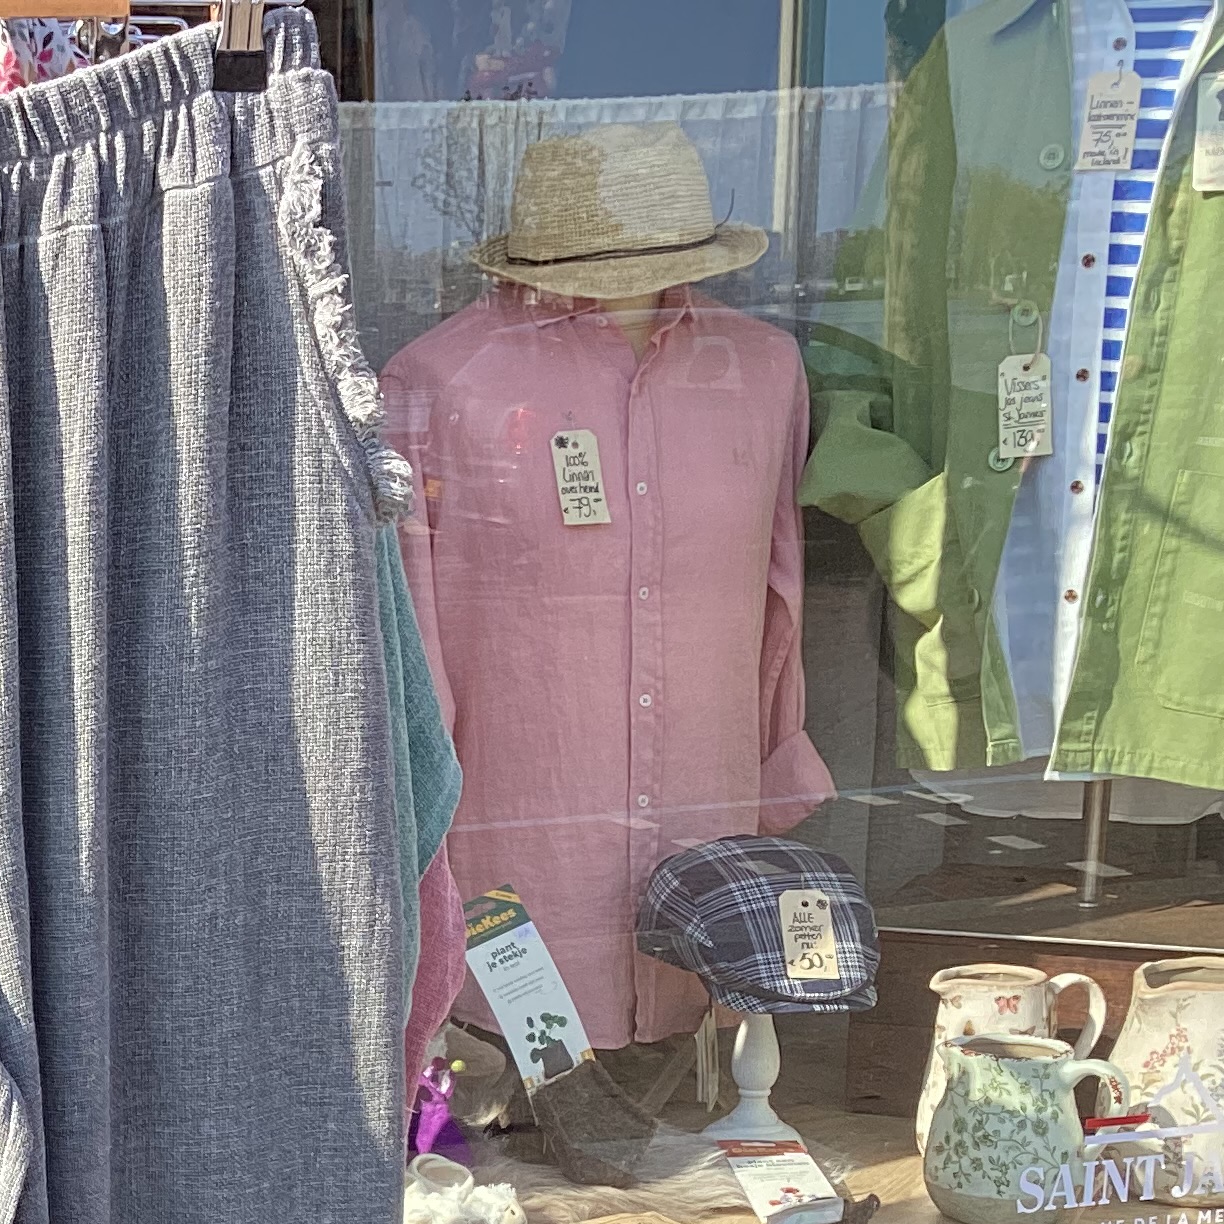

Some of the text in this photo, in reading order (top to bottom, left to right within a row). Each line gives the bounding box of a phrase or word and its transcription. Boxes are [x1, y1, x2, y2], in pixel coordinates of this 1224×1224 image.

[565, 451, 589, 468] 100%
[792, 911, 815, 924] ALLE
[486, 946, 528, 973] je stekje
[490, 941, 518, 961] plant
[1016, 1153, 1166, 1215] SAINT
